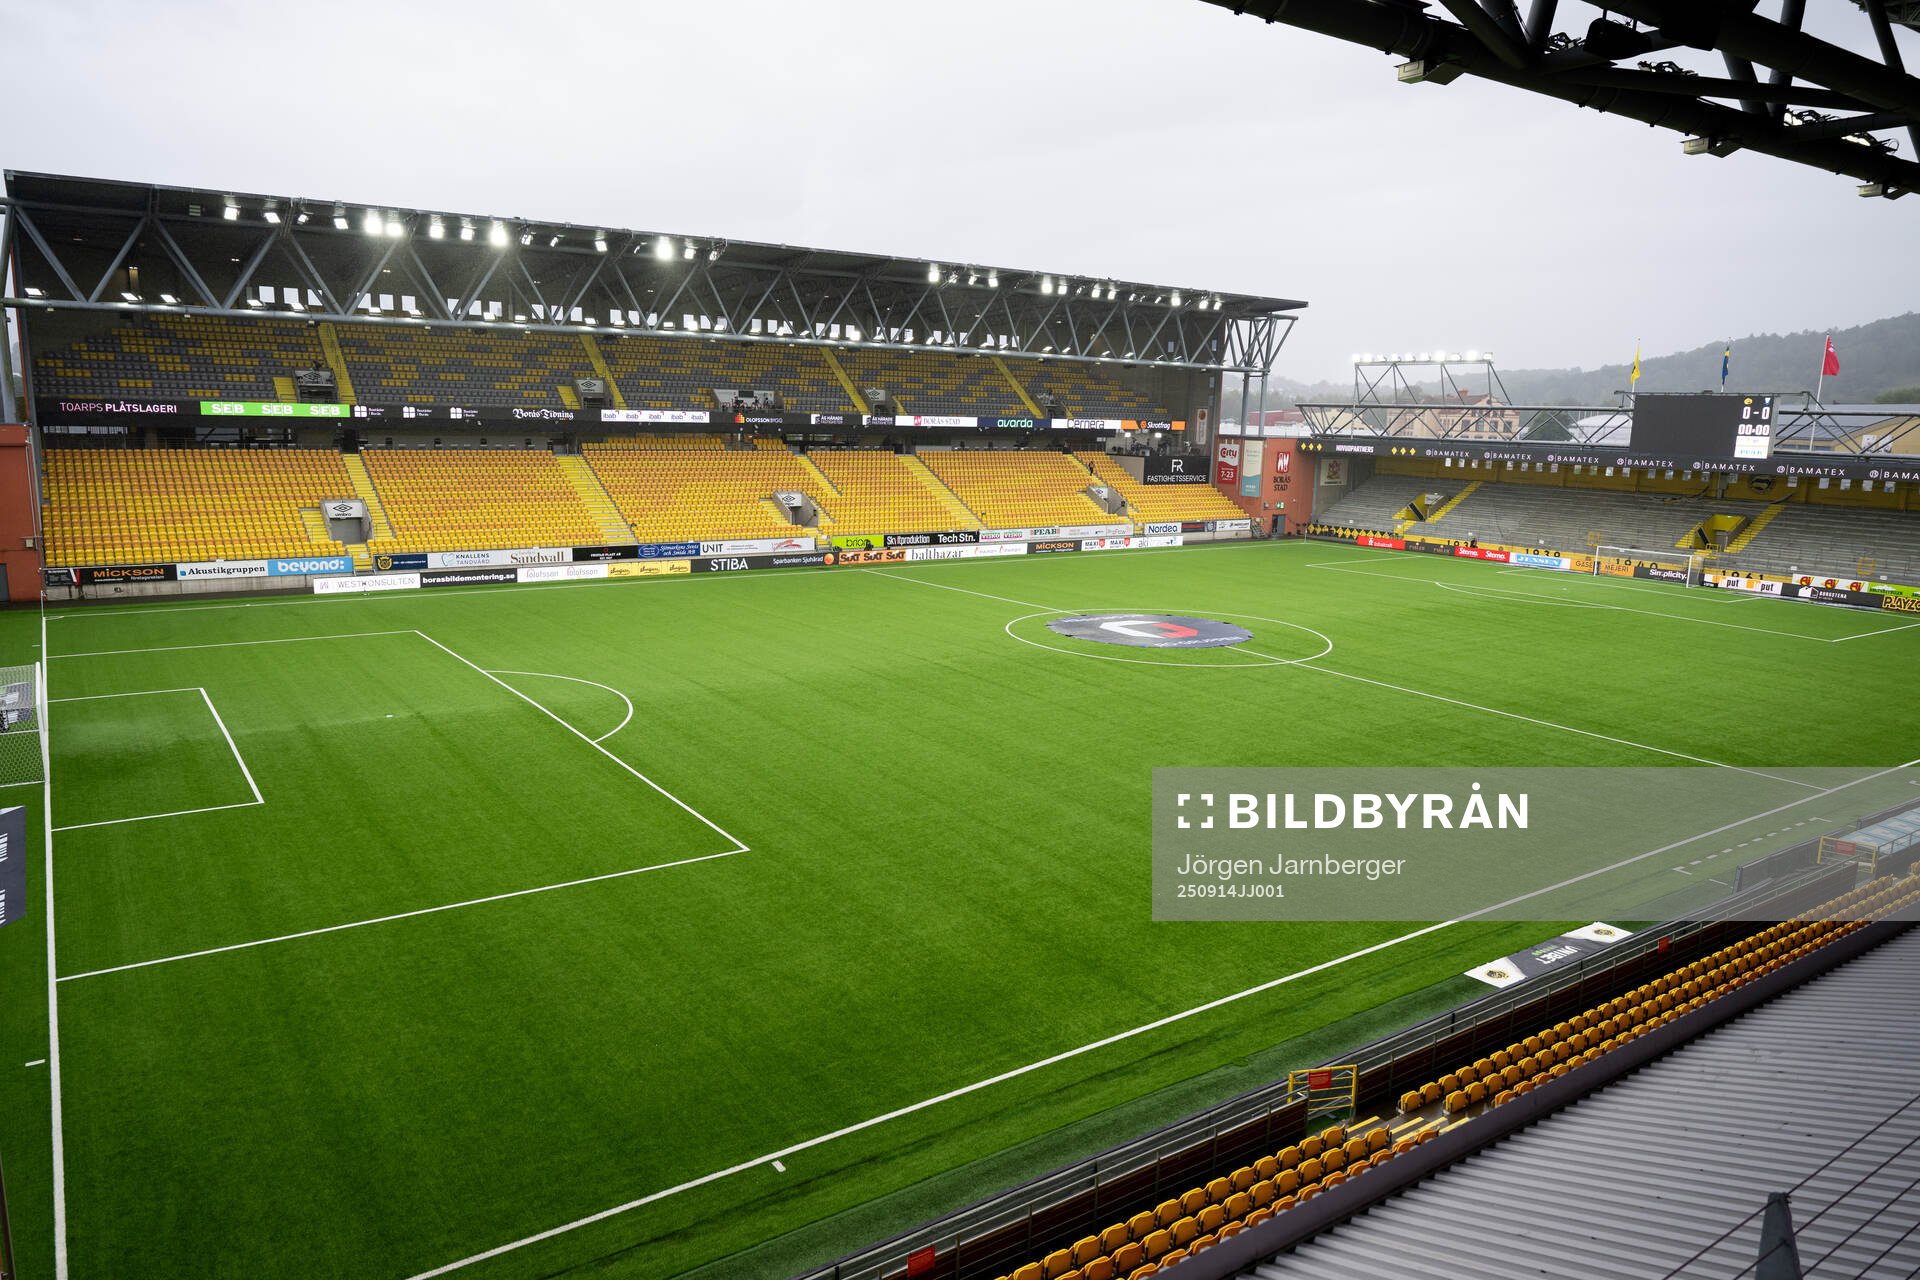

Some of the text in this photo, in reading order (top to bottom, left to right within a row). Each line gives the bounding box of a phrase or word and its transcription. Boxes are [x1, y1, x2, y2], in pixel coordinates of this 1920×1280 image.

[60, 400, 177, 413] TOARPS PLÅTSLAGERI
[211, 403, 244, 414] SEB
[262, 404, 293, 415] SEB
[310, 406, 340, 415] SEB
[512, 408, 574, 420] Borås Tidning
[1742, 406, 1751, 419] 0
[1761, 406, 1771, 420] 0
[997, 418, 1033, 428] avarda
[1220, 447, 1238, 459] City
[1493, 452, 1532, 460] BAMATEX
[1627, 458, 1673, 467] BAMATEX
[1704, 463, 1755, 472] BAMATEX
[1220, 470, 1234, 478] 7-23
[1789, 466, 1845, 476] BAMATEX
[1147, 475, 1206, 483] FASTIGHETSSERVICE
[1148, 525, 1178, 534] Nordea
[938, 533, 958, 544] Tech
[959, 533, 976, 542] Stn.
[702, 543, 723, 553] UNIT
[510, 551, 564, 564] Sandwall
[911, 548, 964, 561] balthazar
[710, 558, 749, 571] STIBA
[772, 556, 823, 565] Sparbanken Sjuhärad
[188, 565, 265, 576] Akustikgruppen
[277, 559, 345, 573] beyond:
[1605, 564, 1629, 573] MEJERI
